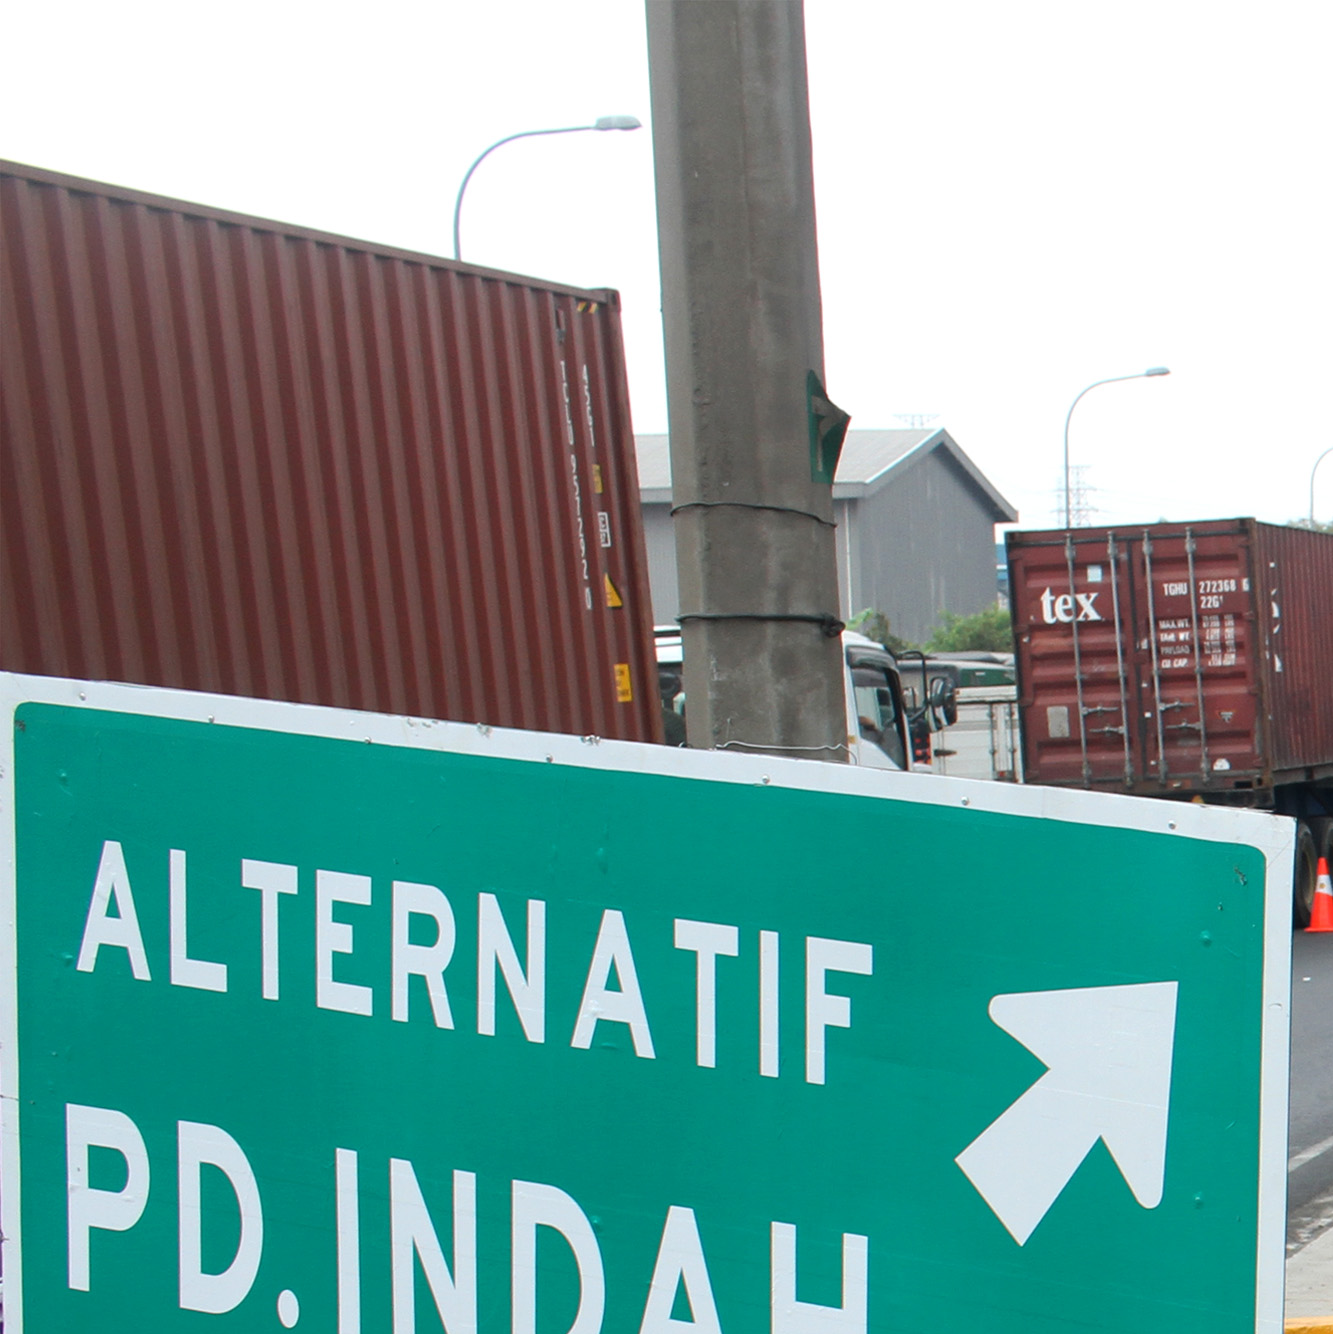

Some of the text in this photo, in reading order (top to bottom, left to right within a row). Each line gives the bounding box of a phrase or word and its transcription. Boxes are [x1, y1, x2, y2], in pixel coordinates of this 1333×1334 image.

[1040, 586, 1102, 625] tex
[1163, 577, 1249, 597] TGHU 272368 6
[78, 839, 874, 1084] ALTERNATIF
